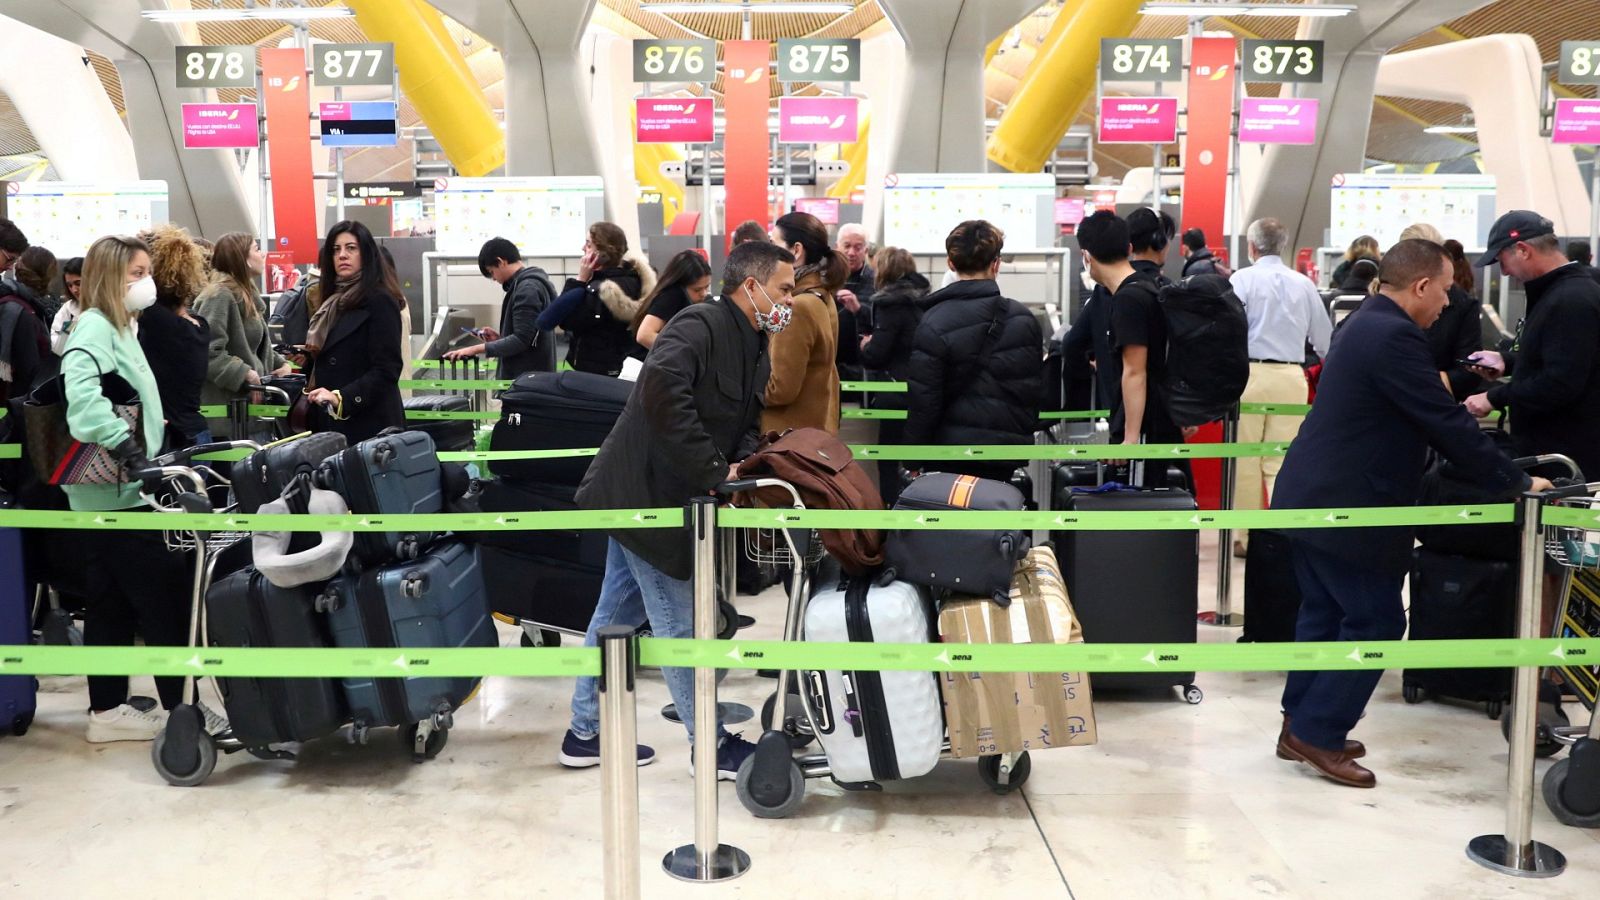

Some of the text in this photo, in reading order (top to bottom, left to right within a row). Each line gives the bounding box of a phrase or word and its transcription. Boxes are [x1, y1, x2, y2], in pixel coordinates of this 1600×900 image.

[186, 52, 244, 80] 878
[323, 50, 383, 78] 877
[644, 46, 704, 74] 876
[789, 45, 849, 73] 875
[1112, 44, 1171, 73] 874
[1253, 46, 1314, 75] 873
[730, 68, 745, 78] IB
[1196, 66, 1210, 75] IB
[268, 77, 282, 87] IB
[789, 115, 831, 125] IBERIA
[1566, 648, 1587, 656] aena
[978, 744, 996, 753] 6-0
